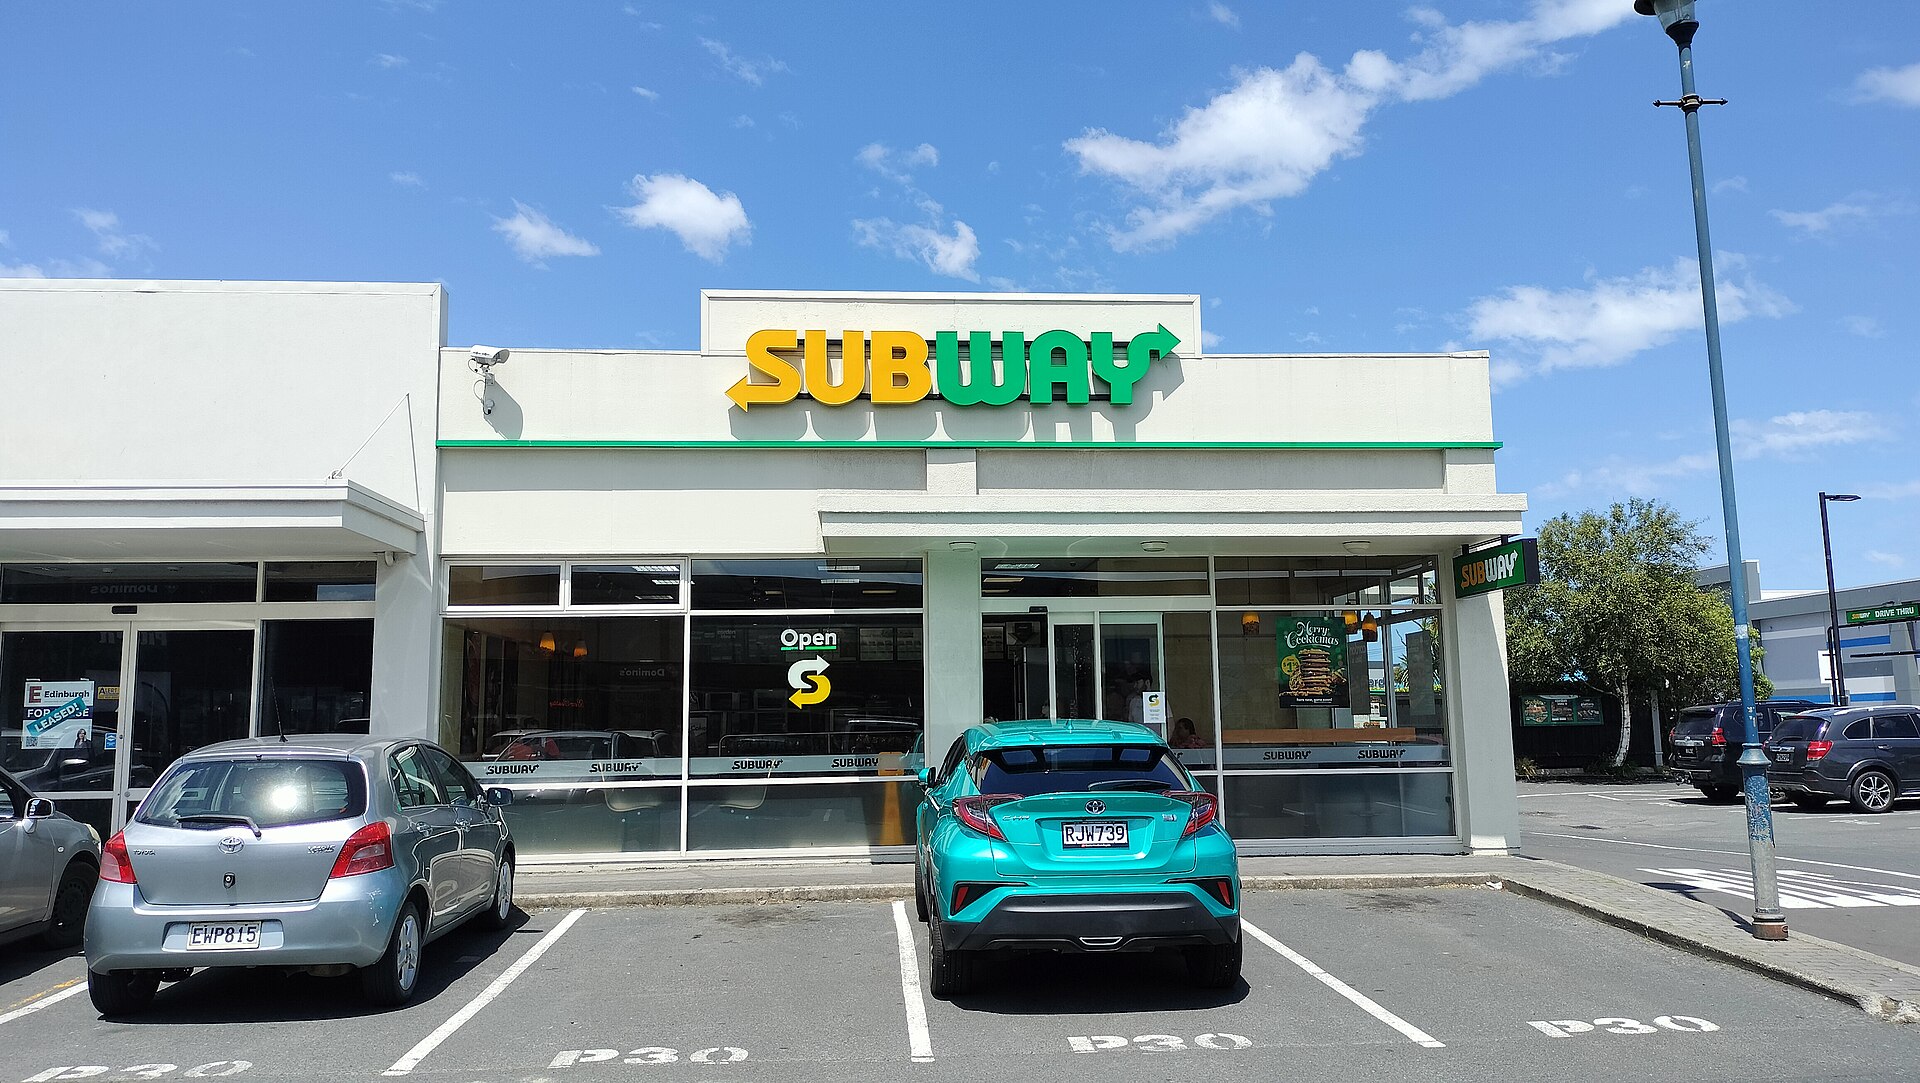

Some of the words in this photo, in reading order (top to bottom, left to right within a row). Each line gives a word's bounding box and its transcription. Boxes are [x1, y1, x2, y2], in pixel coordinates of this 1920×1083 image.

[725, 323, 1181, 412] SUBWAY
[1461, 550, 1518, 590] SUBWAY
[1874, 609, 1895, 618] DRIVE
[1896, 606, 1914, 616] THRU
[1296, 620, 1329, 636] Merry
[780, 628, 837, 650] Open
[1284, 631, 1340, 649] Cookiemas
[44, 690, 90, 699] Edinburgh
[34, 702, 80, 733] LEASED!
[1262, 750, 1311, 761] SUBWAY
[1357, 748, 1406, 760] SUBWAY
[486, 764, 539, 775] SUBWAY
[589, 761, 642, 773] SUBWAY
[732, 758, 783, 771] SUBWAY
[831, 757, 879, 769] SUBWAY
[1065, 825, 1126, 842] RJW739
[192, 926, 257, 944] EWP815
[1526, 1015, 1721, 1038] P30
[1066, 1032, 1253, 1054] P30
[547, 1046, 749, 1069] P30
[20, 1060, 253, 1083] P30
